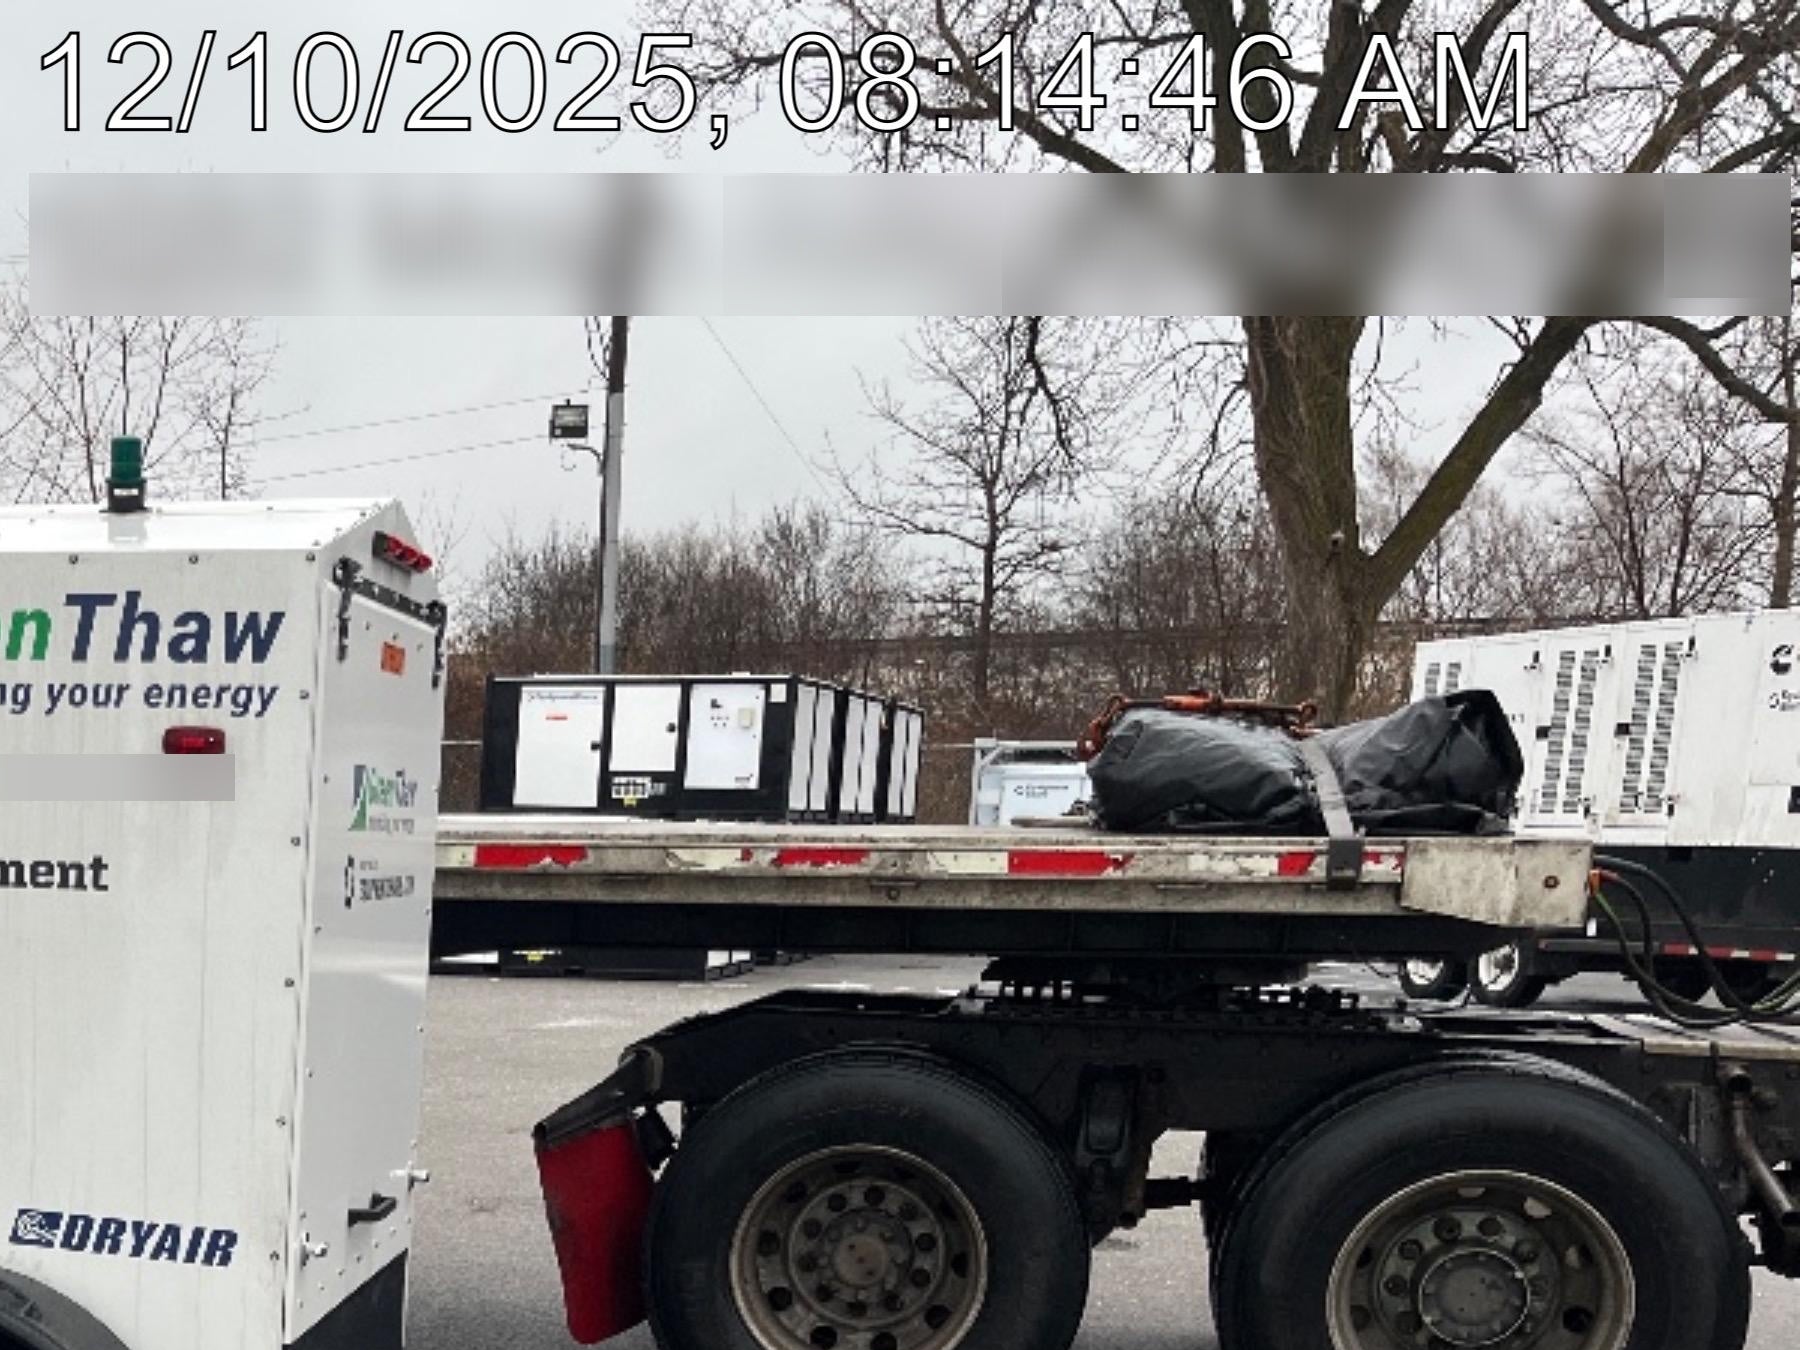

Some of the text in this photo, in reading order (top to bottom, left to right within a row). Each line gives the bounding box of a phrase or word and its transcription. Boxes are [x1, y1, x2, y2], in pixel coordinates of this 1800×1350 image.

[44, 679, 131, 717] your
[143, 679, 280, 718] energy
[59, 1213, 238, 1267] DRYAIR
